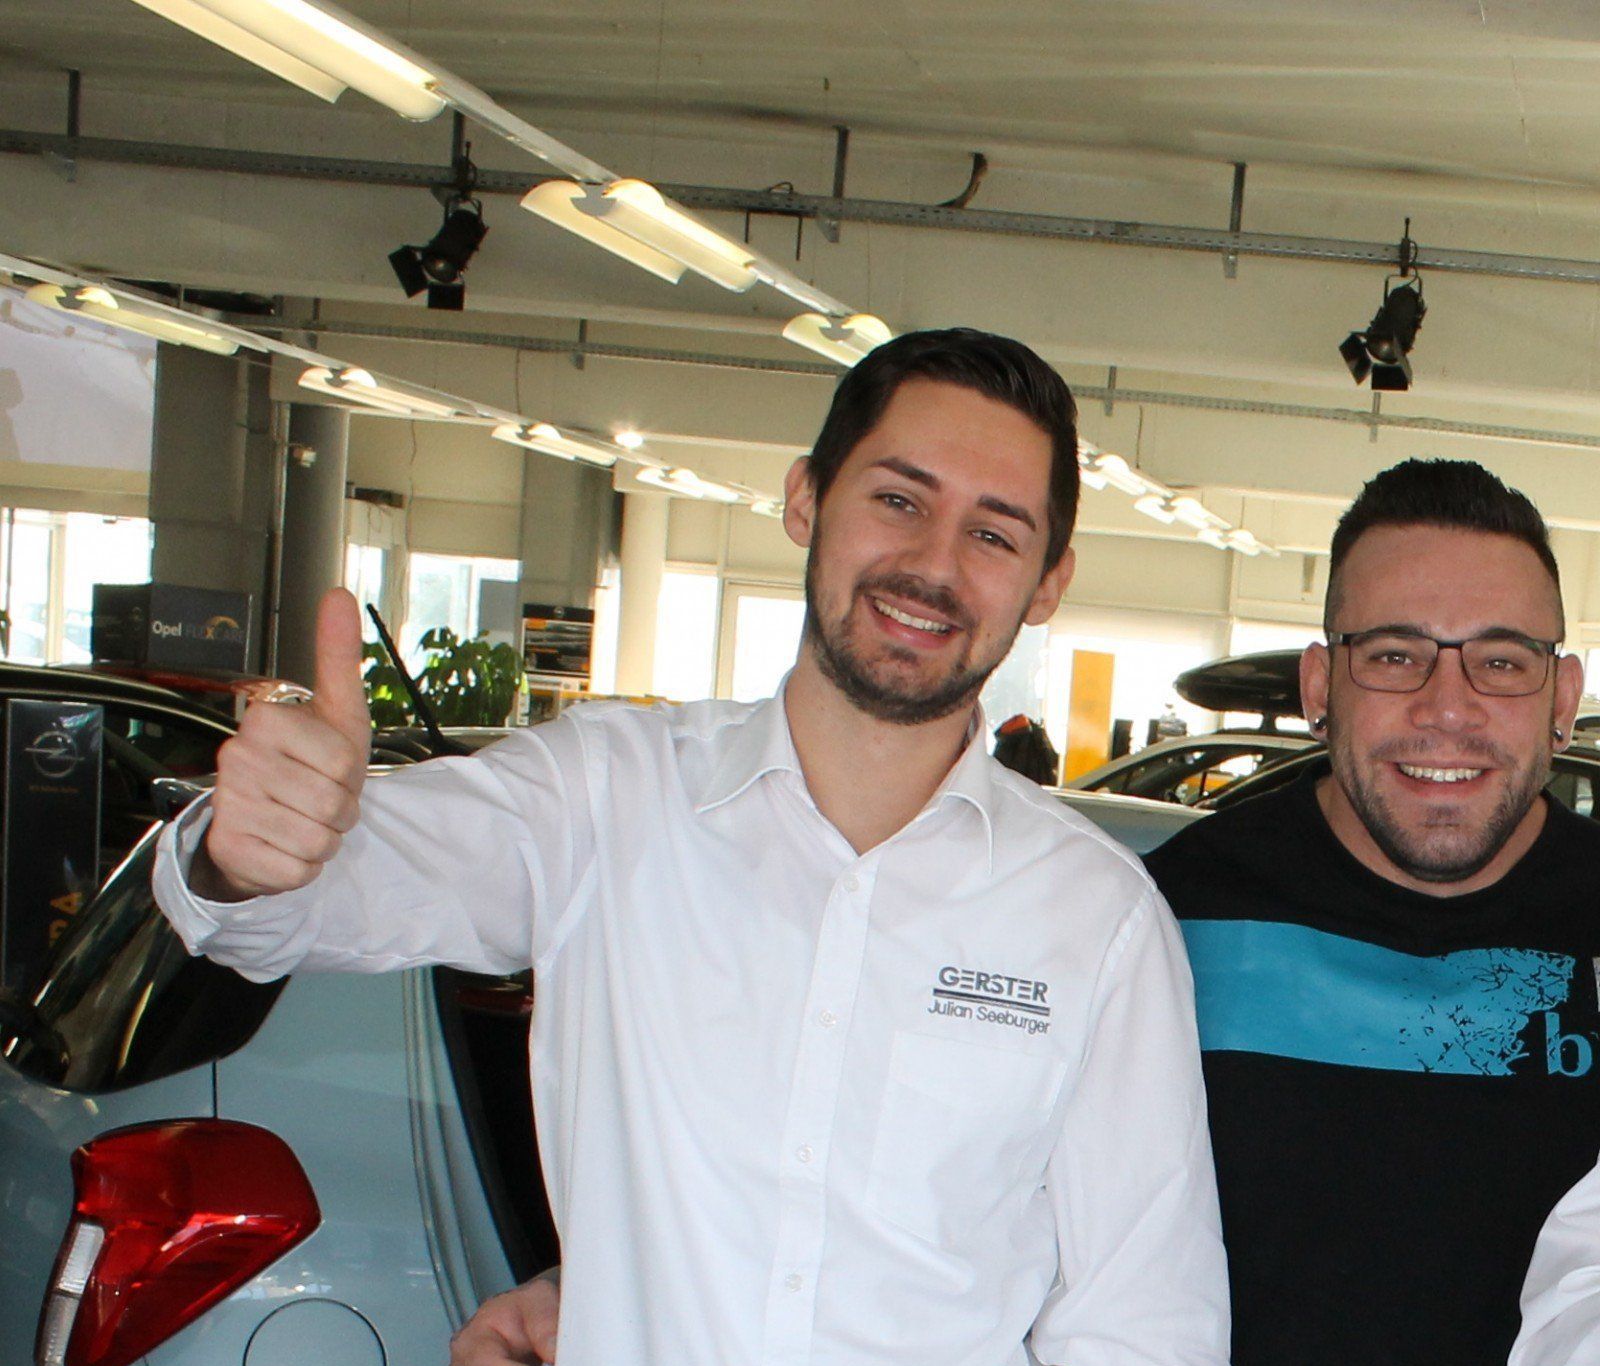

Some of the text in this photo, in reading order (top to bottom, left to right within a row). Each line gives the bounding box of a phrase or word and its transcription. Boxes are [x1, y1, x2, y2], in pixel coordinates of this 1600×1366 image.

[152, 620, 182, 638] Opel
[938, 966, 1048, 1003] GERSTER
[927, 999, 1051, 1035] Julian Seeburger
